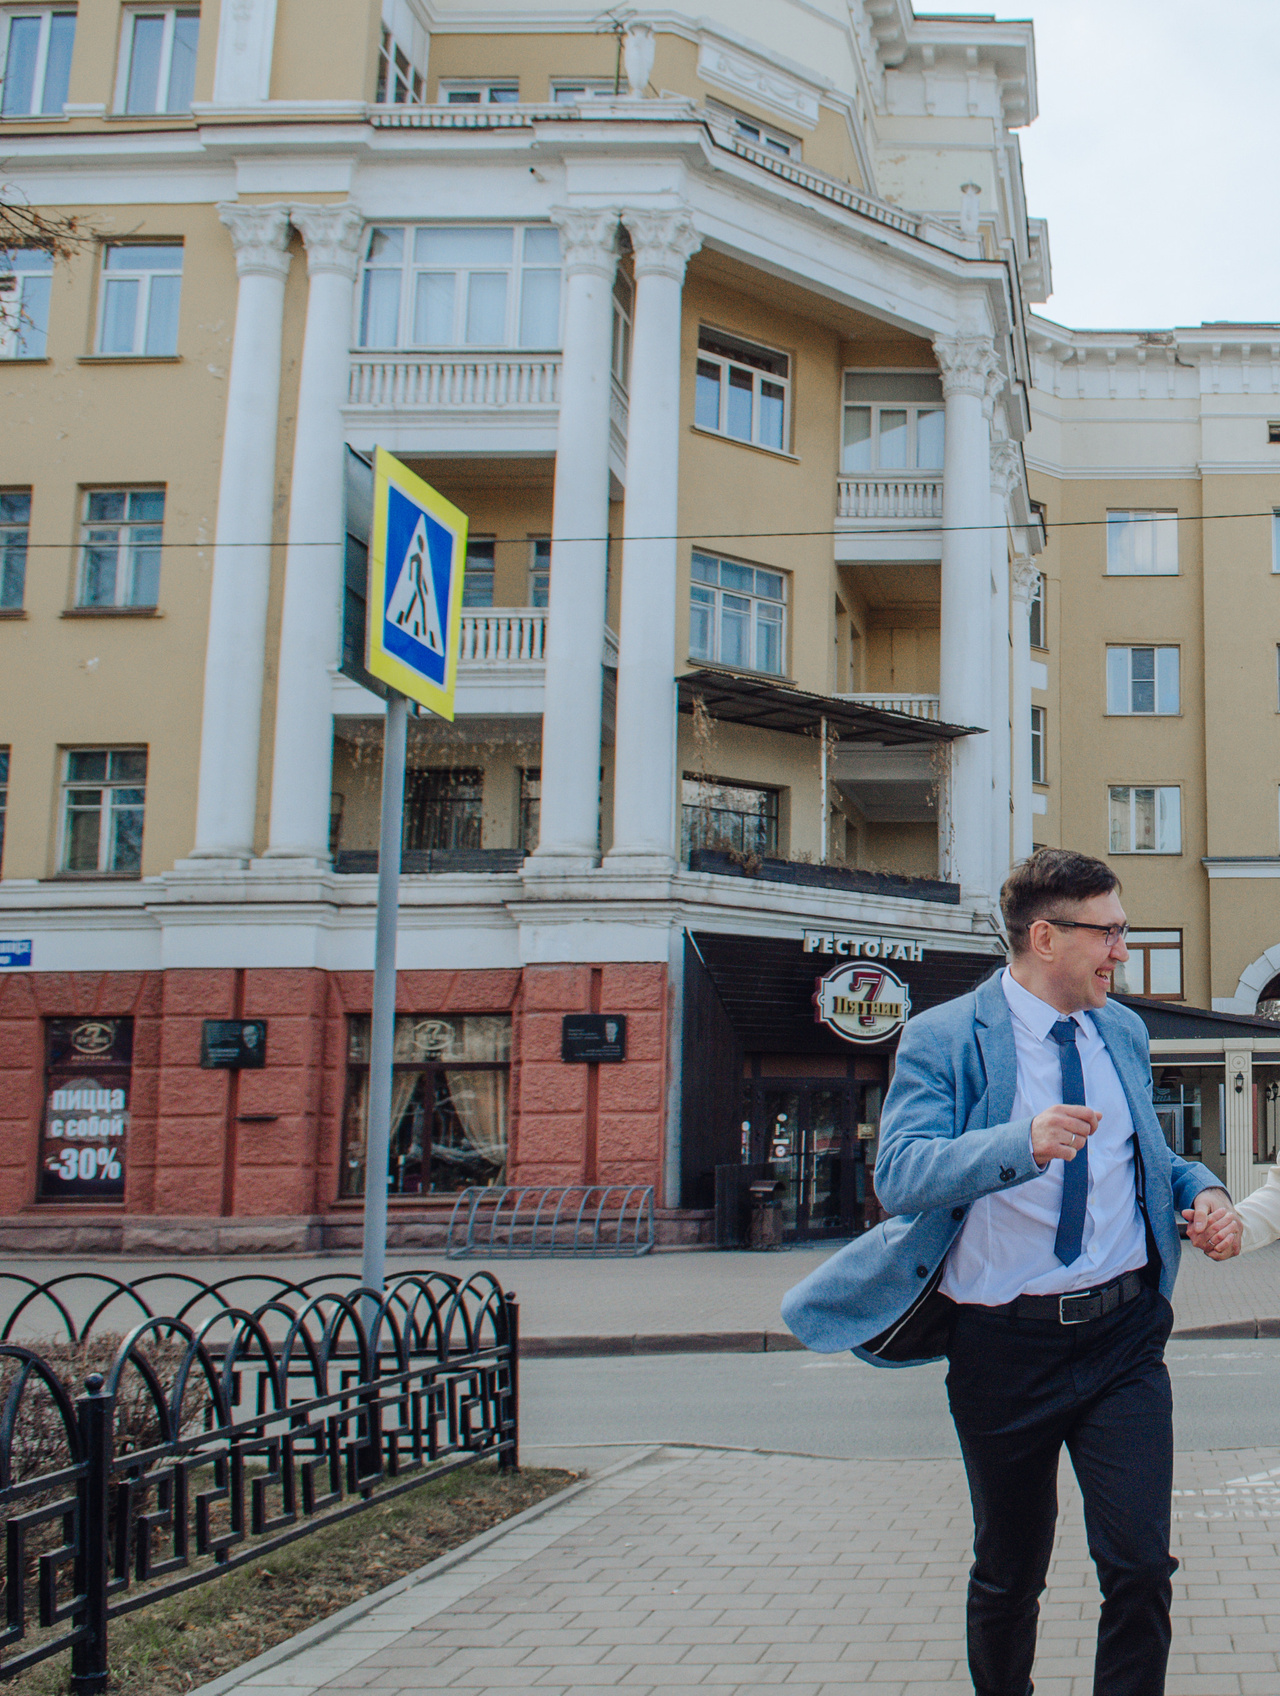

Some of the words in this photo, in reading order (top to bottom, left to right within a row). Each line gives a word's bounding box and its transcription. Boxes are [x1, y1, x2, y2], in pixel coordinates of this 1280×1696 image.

[804, 936, 923, 962] РЕСТОРАН
[834, 996, 902, 1017] Пятниц
[849, 971, 886, 1026] 7
[52, 1089, 125, 1113] пицца
[51, 1119, 64, 1136] с
[65, 1115, 123, 1136] собой
[49, 1147, 121, 1180] -30%
